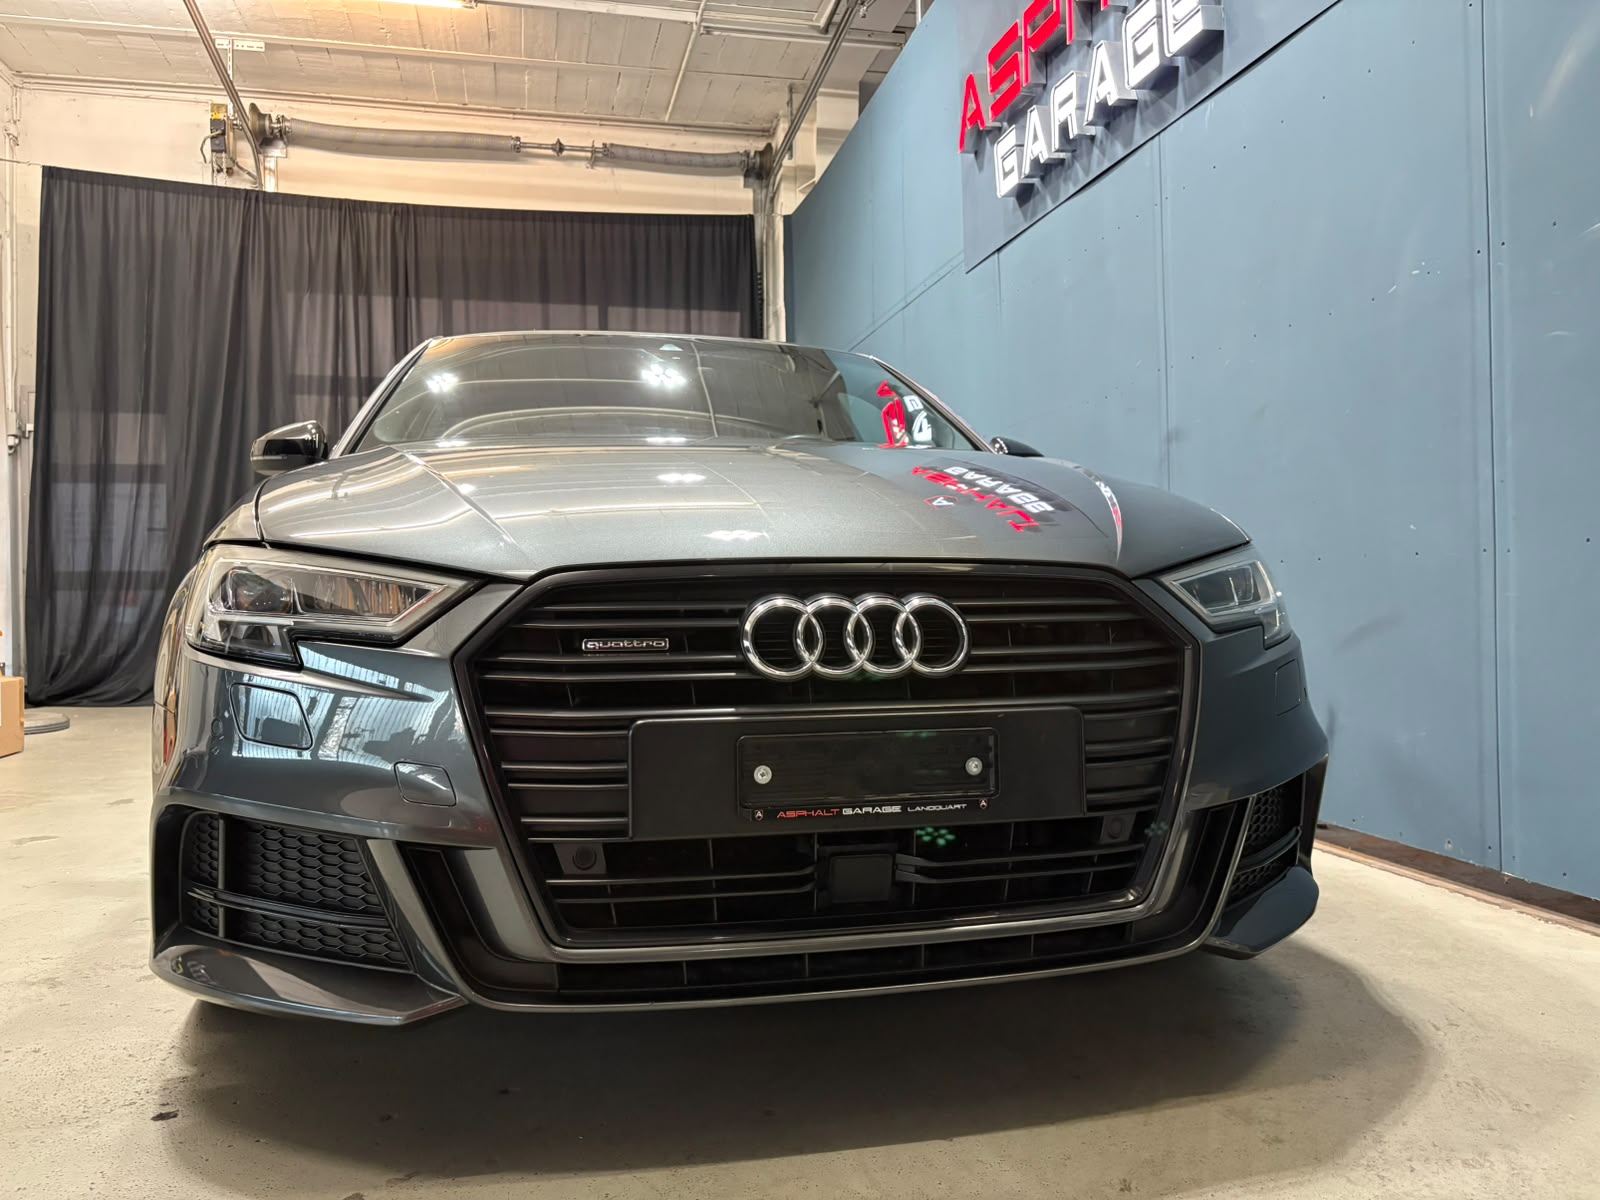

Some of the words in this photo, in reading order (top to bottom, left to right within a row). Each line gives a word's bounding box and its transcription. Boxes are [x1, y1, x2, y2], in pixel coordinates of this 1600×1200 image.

[994, 0, 1204, 198] GARAGE
[586, 640, 666, 650] quattro
[777, 808, 840, 819] ASPHALT
[842, 805, 902, 816] GARAGE
[907, 803, 967, 812] LANDQUART
